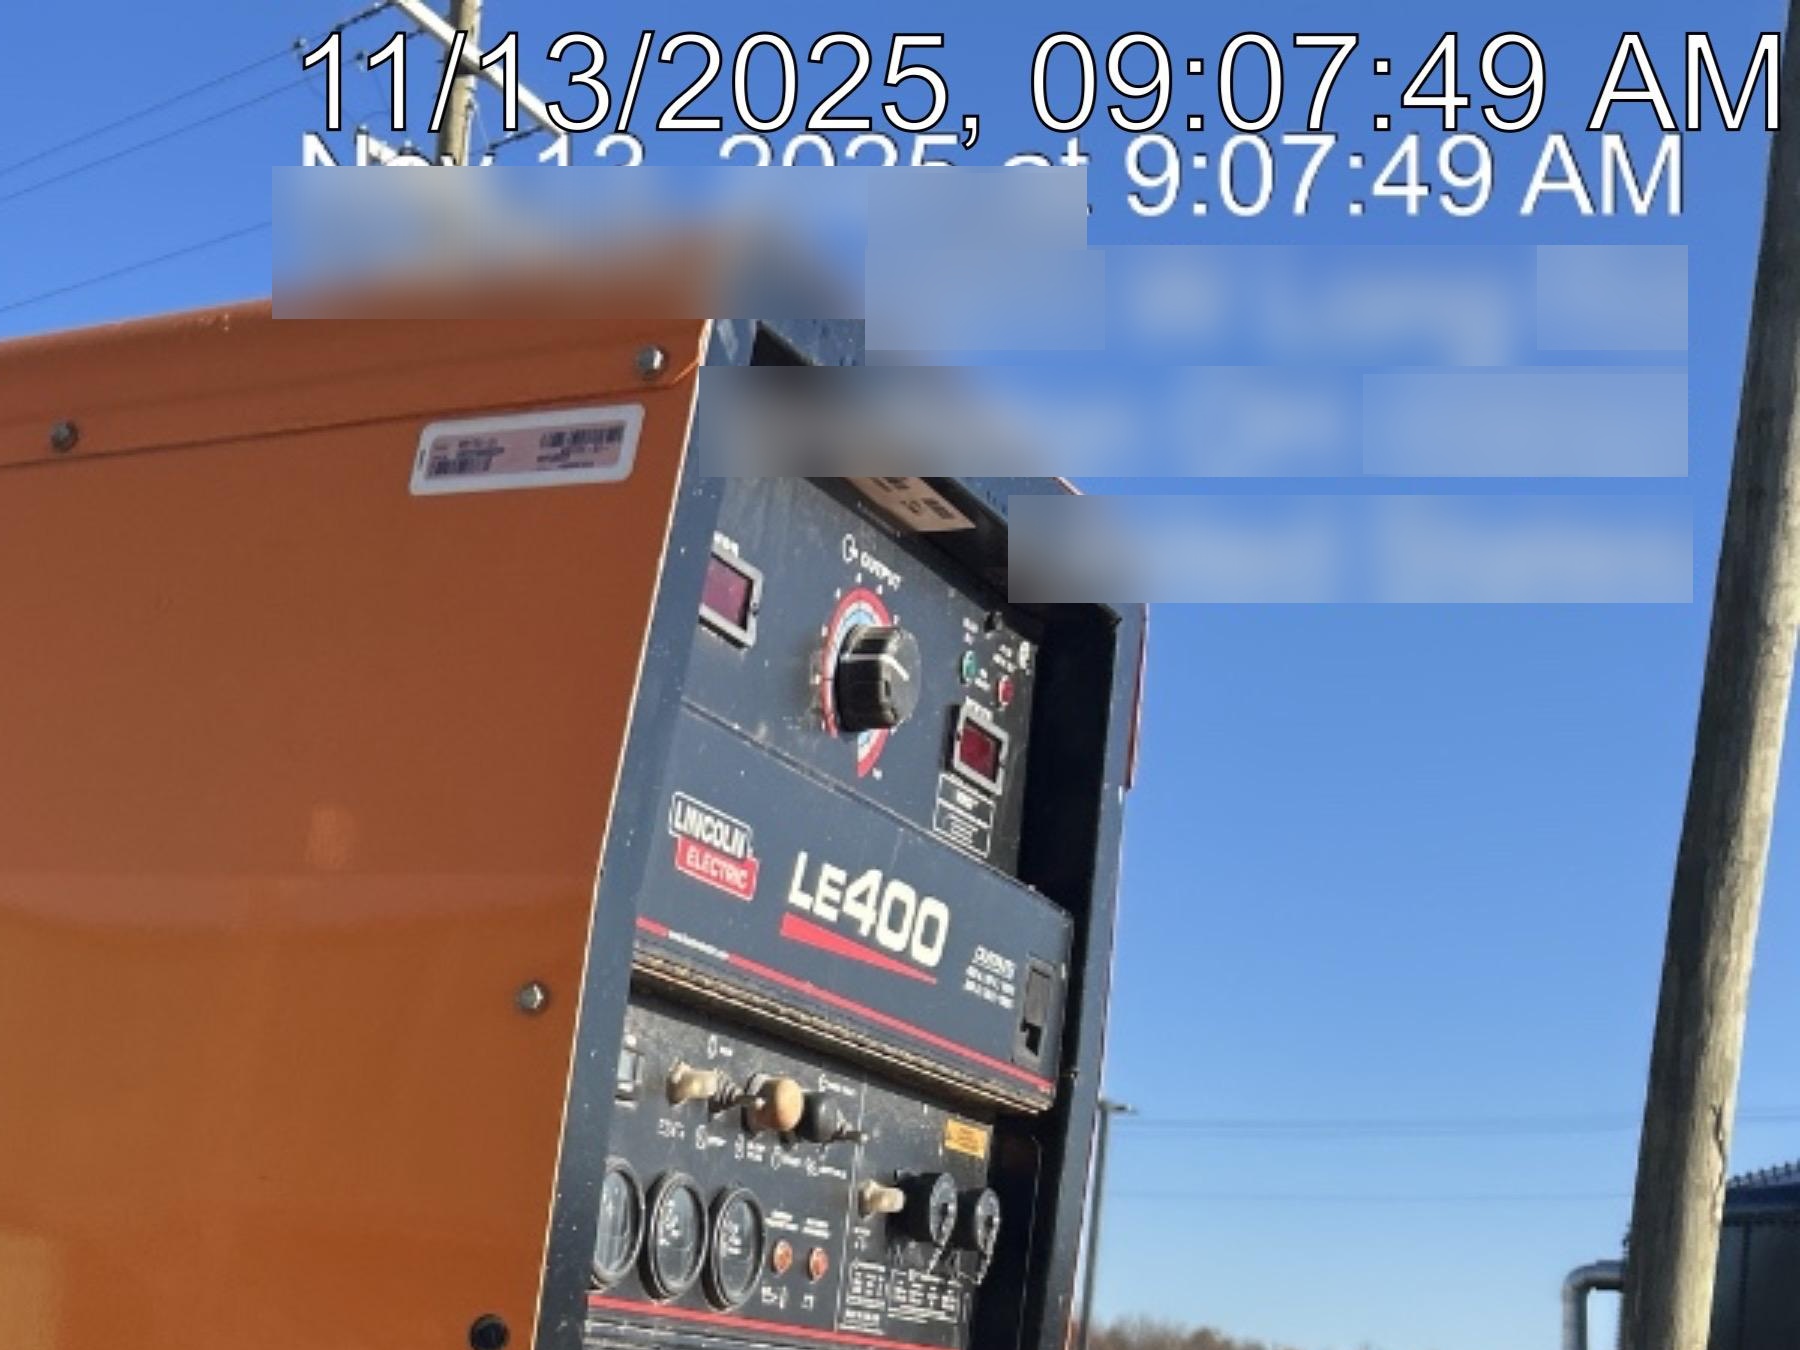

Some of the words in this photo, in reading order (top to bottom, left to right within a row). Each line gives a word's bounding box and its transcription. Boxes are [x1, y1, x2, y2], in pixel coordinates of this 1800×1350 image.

[674, 799, 748, 859] LINCOLN
[686, 843, 749, 891] ELECTRIC
[787, 850, 950, 968] LE400
